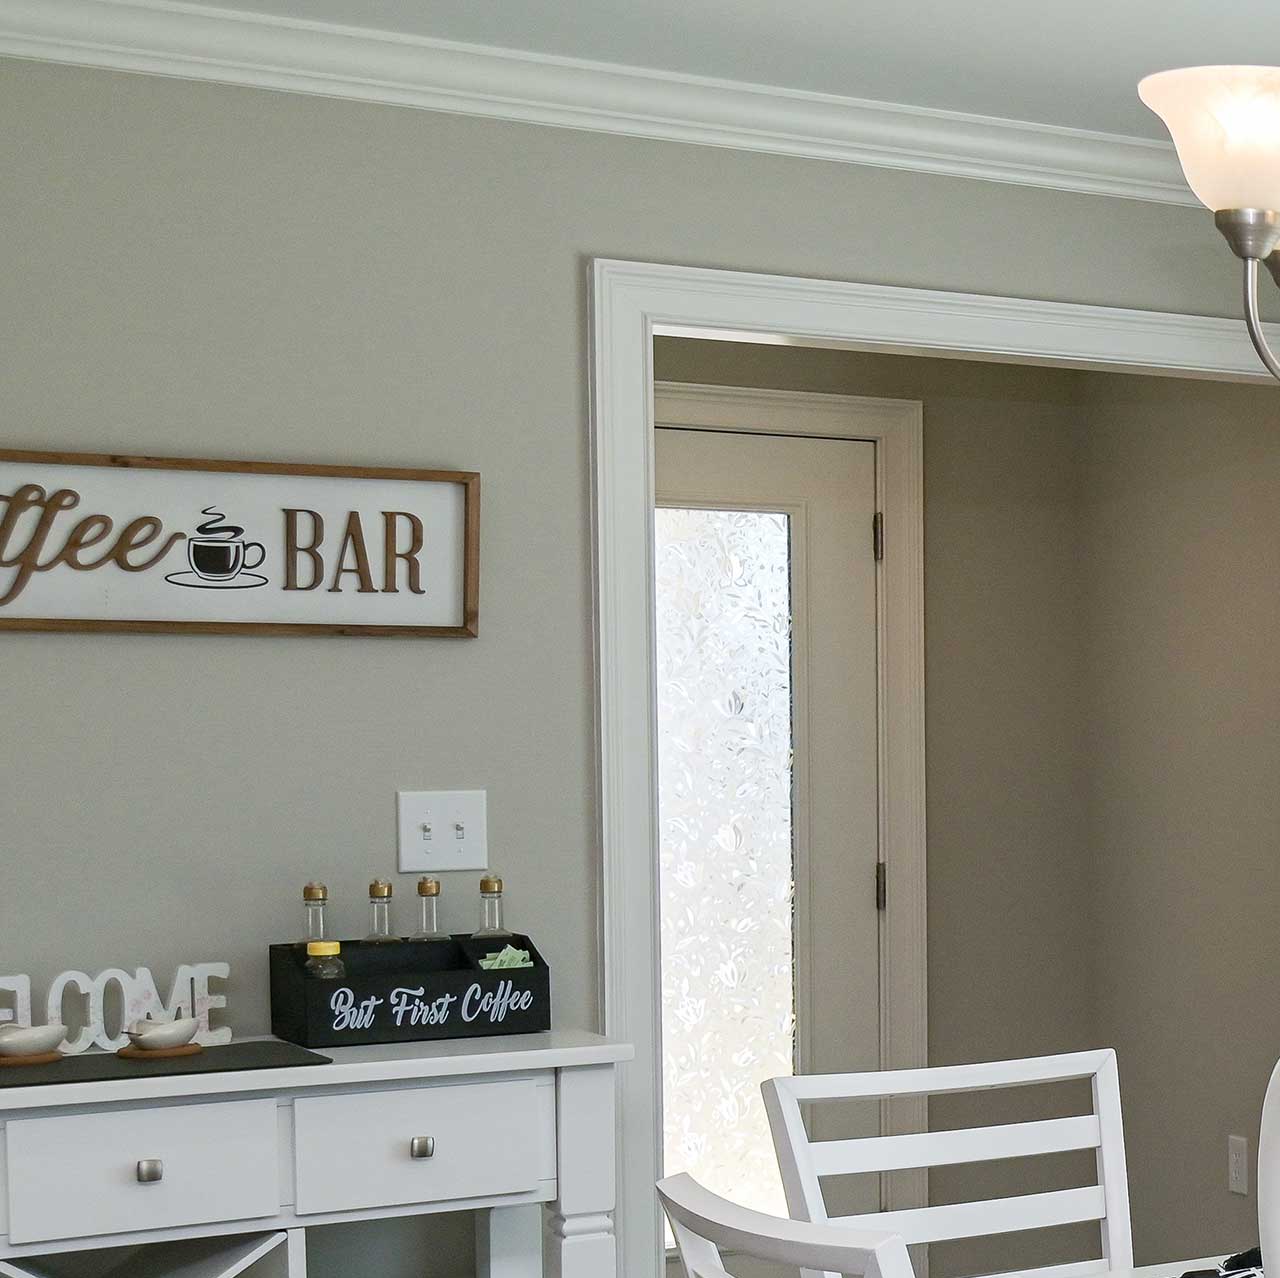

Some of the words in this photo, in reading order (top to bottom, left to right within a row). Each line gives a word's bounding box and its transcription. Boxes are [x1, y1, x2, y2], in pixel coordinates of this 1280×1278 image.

[282, 508, 426, 595] BAR
[330, 987, 384, 1031] But
[390, 986, 457, 1027] First
[461, 980, 533, 1023] Coffee
